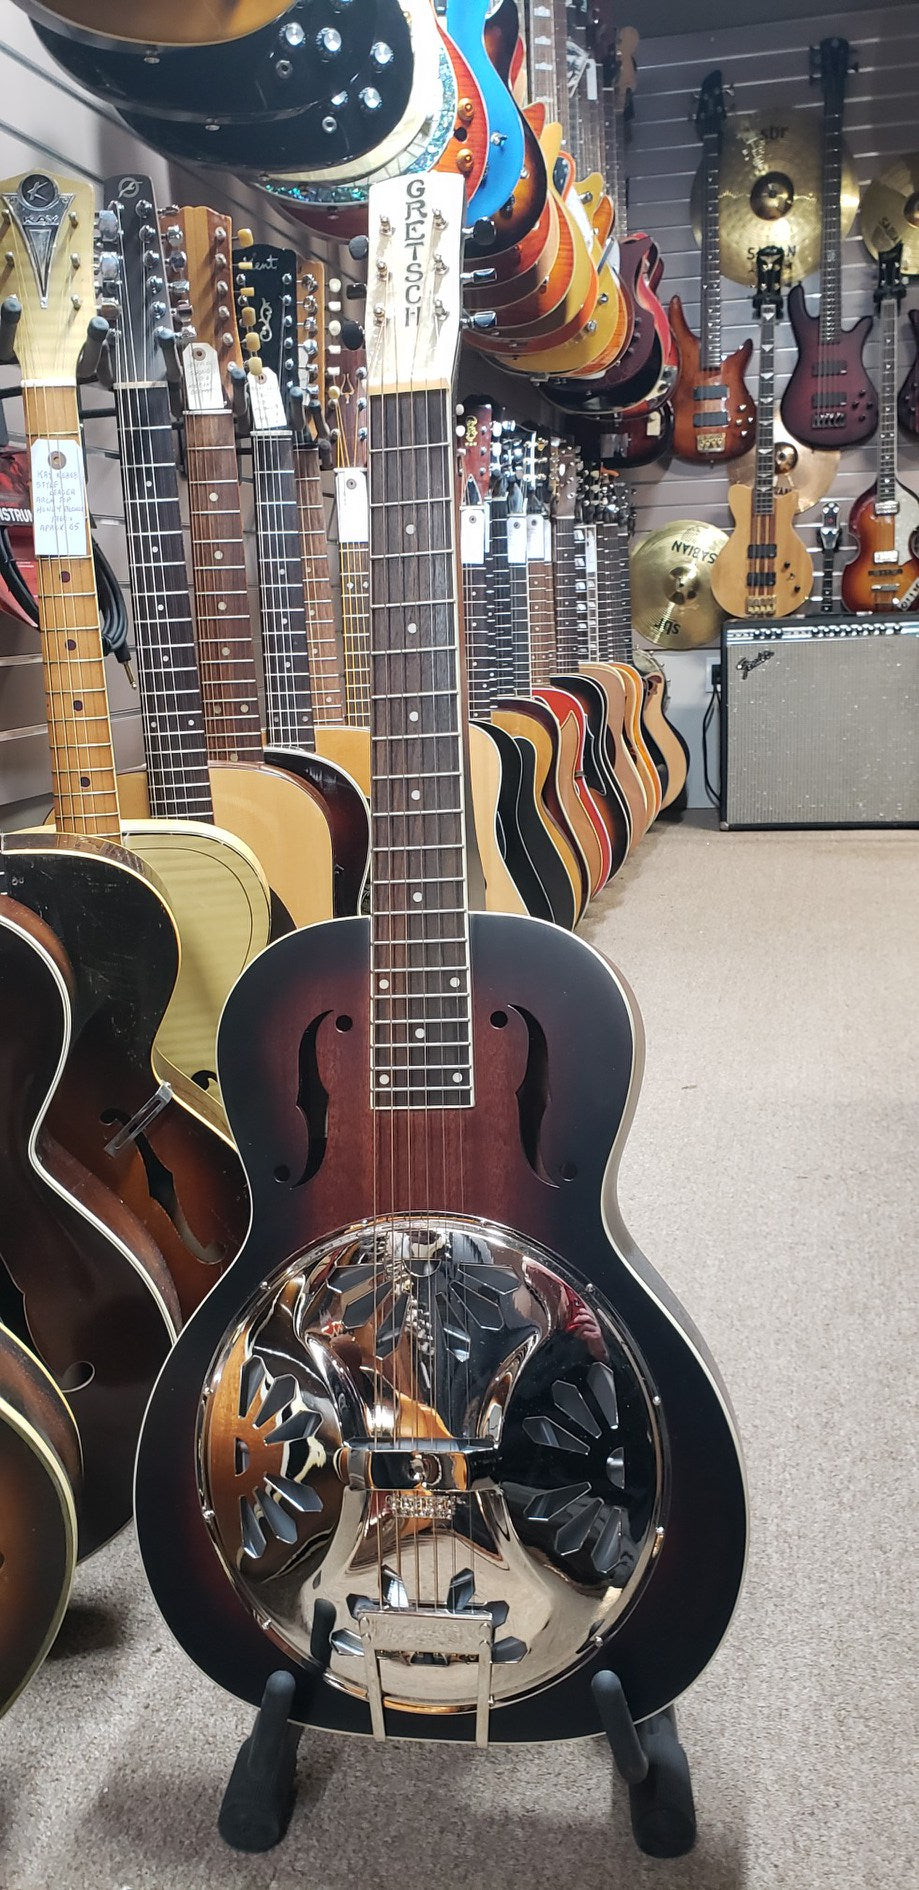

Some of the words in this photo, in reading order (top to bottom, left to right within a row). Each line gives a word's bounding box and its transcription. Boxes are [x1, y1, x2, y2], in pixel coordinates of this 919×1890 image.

[23, 214, 59, 226] KAY
[404, 179, 428, 327] GRETSCH
[671, 540, 718, 564] SABIAN
[654, 617, 682, 635] sbr
